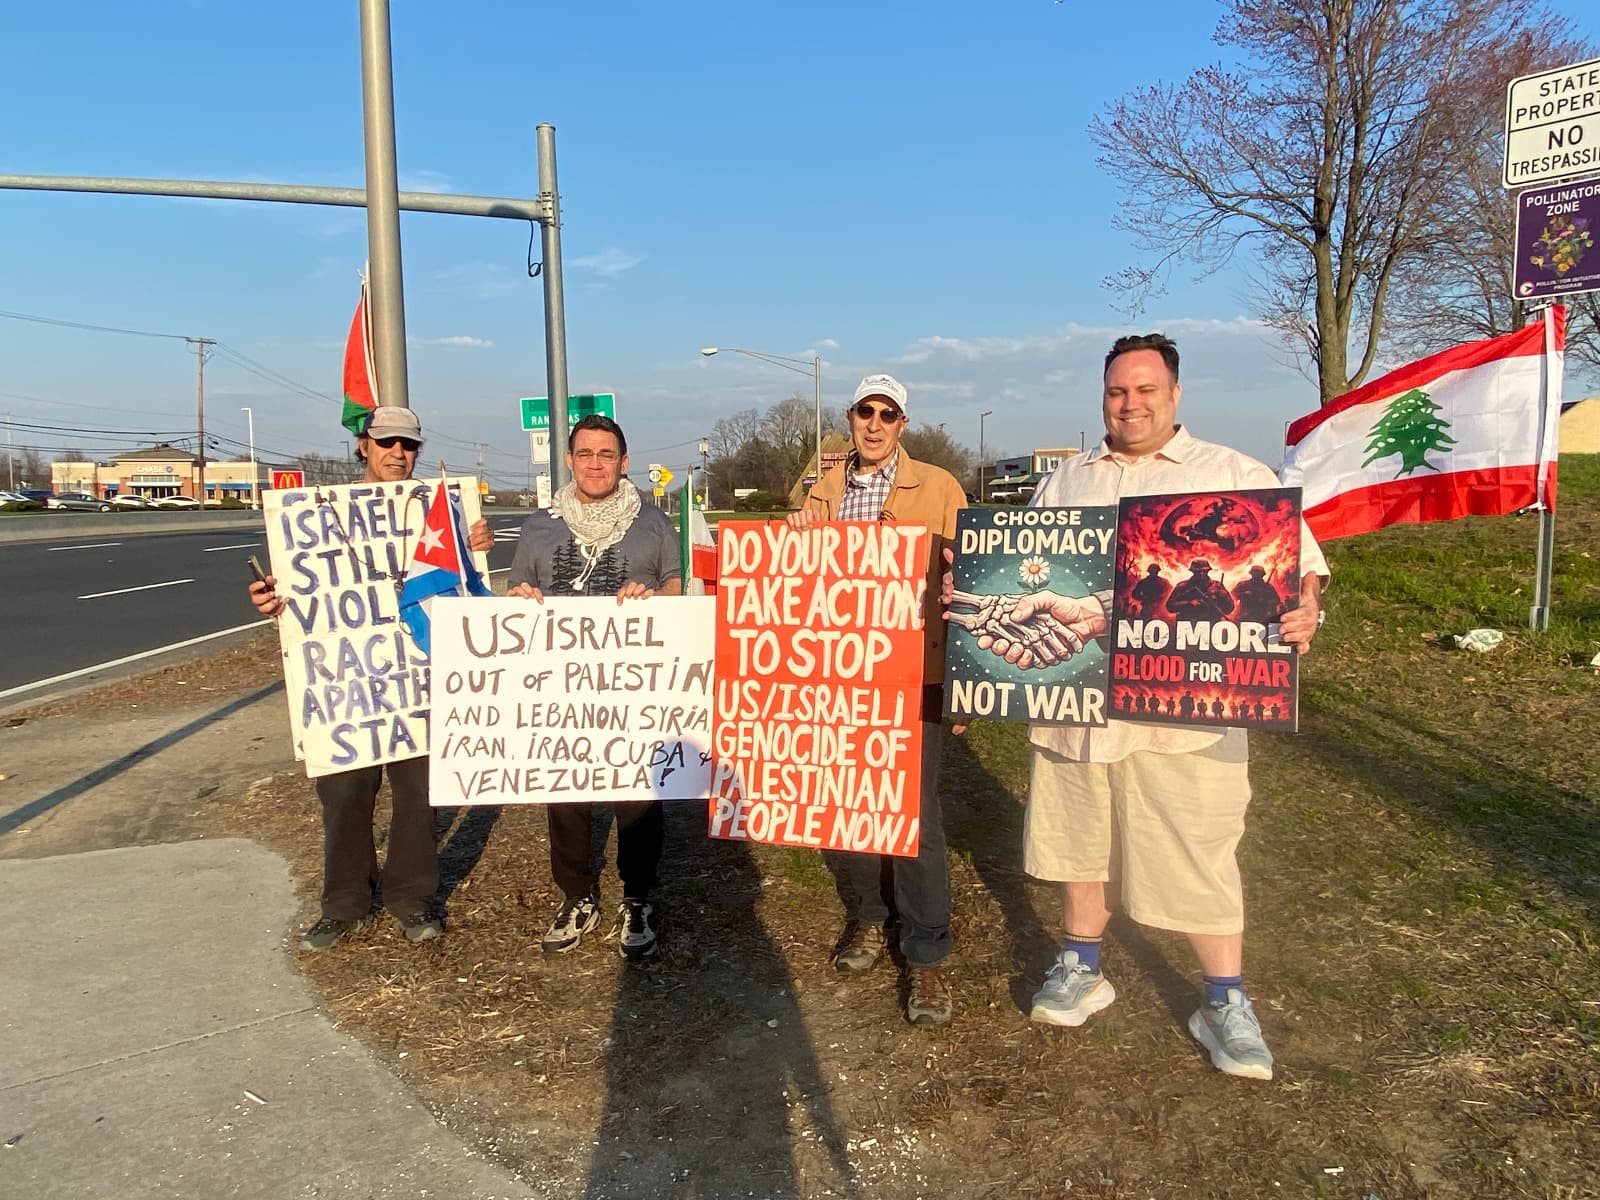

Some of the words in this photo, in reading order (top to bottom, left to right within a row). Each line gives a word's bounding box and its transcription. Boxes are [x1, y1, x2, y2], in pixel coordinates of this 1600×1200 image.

[1540, 69, 1600, 97] STATE
[1516, 90, 1600, 123] PROPER
[1548, 125, 1583, 150] NO
[1512, 147, 1600, 177] TRESPASSI
[1526, 184, 1600, 208] POLLINATOR
[1546, 201, 1580, 217] ZONE
[531, 413, 580, 426] RANAS
[281, 498, 413, 551] ISRAEL
[993, 510, 1082, 526] CHOOSE
[721, 528, 762, 576] DO
[763, 525, 843, 578] YOUR
[846, 525, 927, 578] PART
[961, 528, 1114, 555] DIPLOMACY
[291, 542, 408, 595] STILL
[287, 585, 399, 635] VIOL
[720, 576, 803, 626] TAKE
[804, 575, 927, 630] ACTION
[1117, 619, 1170, 650] NO
[302, 631, 430, 685] RACI
[729, 629, 781, 677] TO
[786, 628, 893, 682] STOP
[1114, 654, 1185, 682] BLOOD
[1189, 661, 1223, 683] FOR
[1225, 657, 1291, 688] WAR
[445, 668, 505, 696] OUT
[523, 671, 552, 692] OF
[565, 657, 713, 695] PALESTIN
[303, 667, 430, 728] APARTH
[445, 705, 500, 727] AND
[951, 679, 1015, 717] NOT
[1025, 684, 1105, 724] WAR
[330, 709, 430, 765] STAT
[603, 736, 684, 769] CUBA
[715, 720, 858, 767] GENOCIDE
[865, 729, 912, 769] OF
[712, 757, 906, 813] PALESTINIAN
[711, 797, 827, 844] PEOPLE
[829, 808, 919, 853] NOW!
